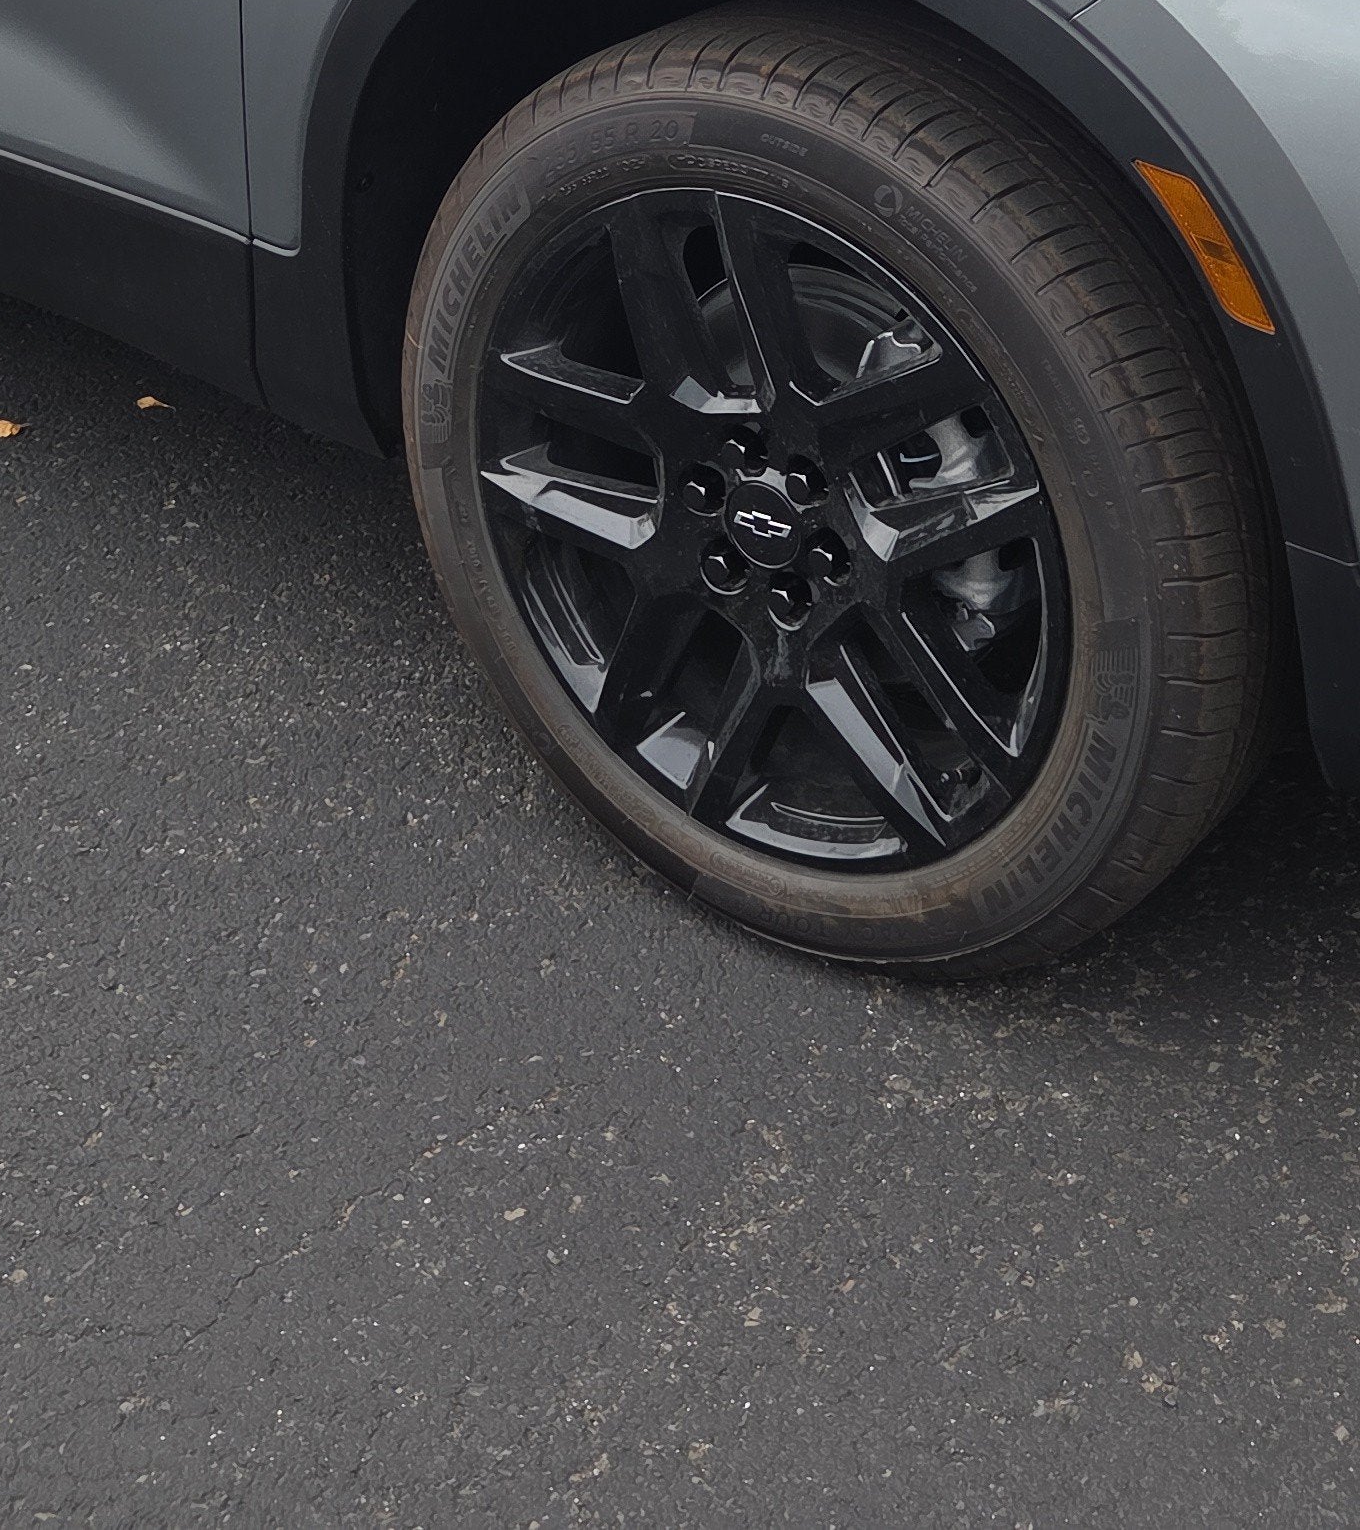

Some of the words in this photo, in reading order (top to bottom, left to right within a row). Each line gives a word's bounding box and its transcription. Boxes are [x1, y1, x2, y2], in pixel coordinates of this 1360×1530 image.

[428, 182, 524, 376] MICHELIN
[905, 205, 969, 264] MICHELIN
[978, 730, 1117, 913] MICHELIN
